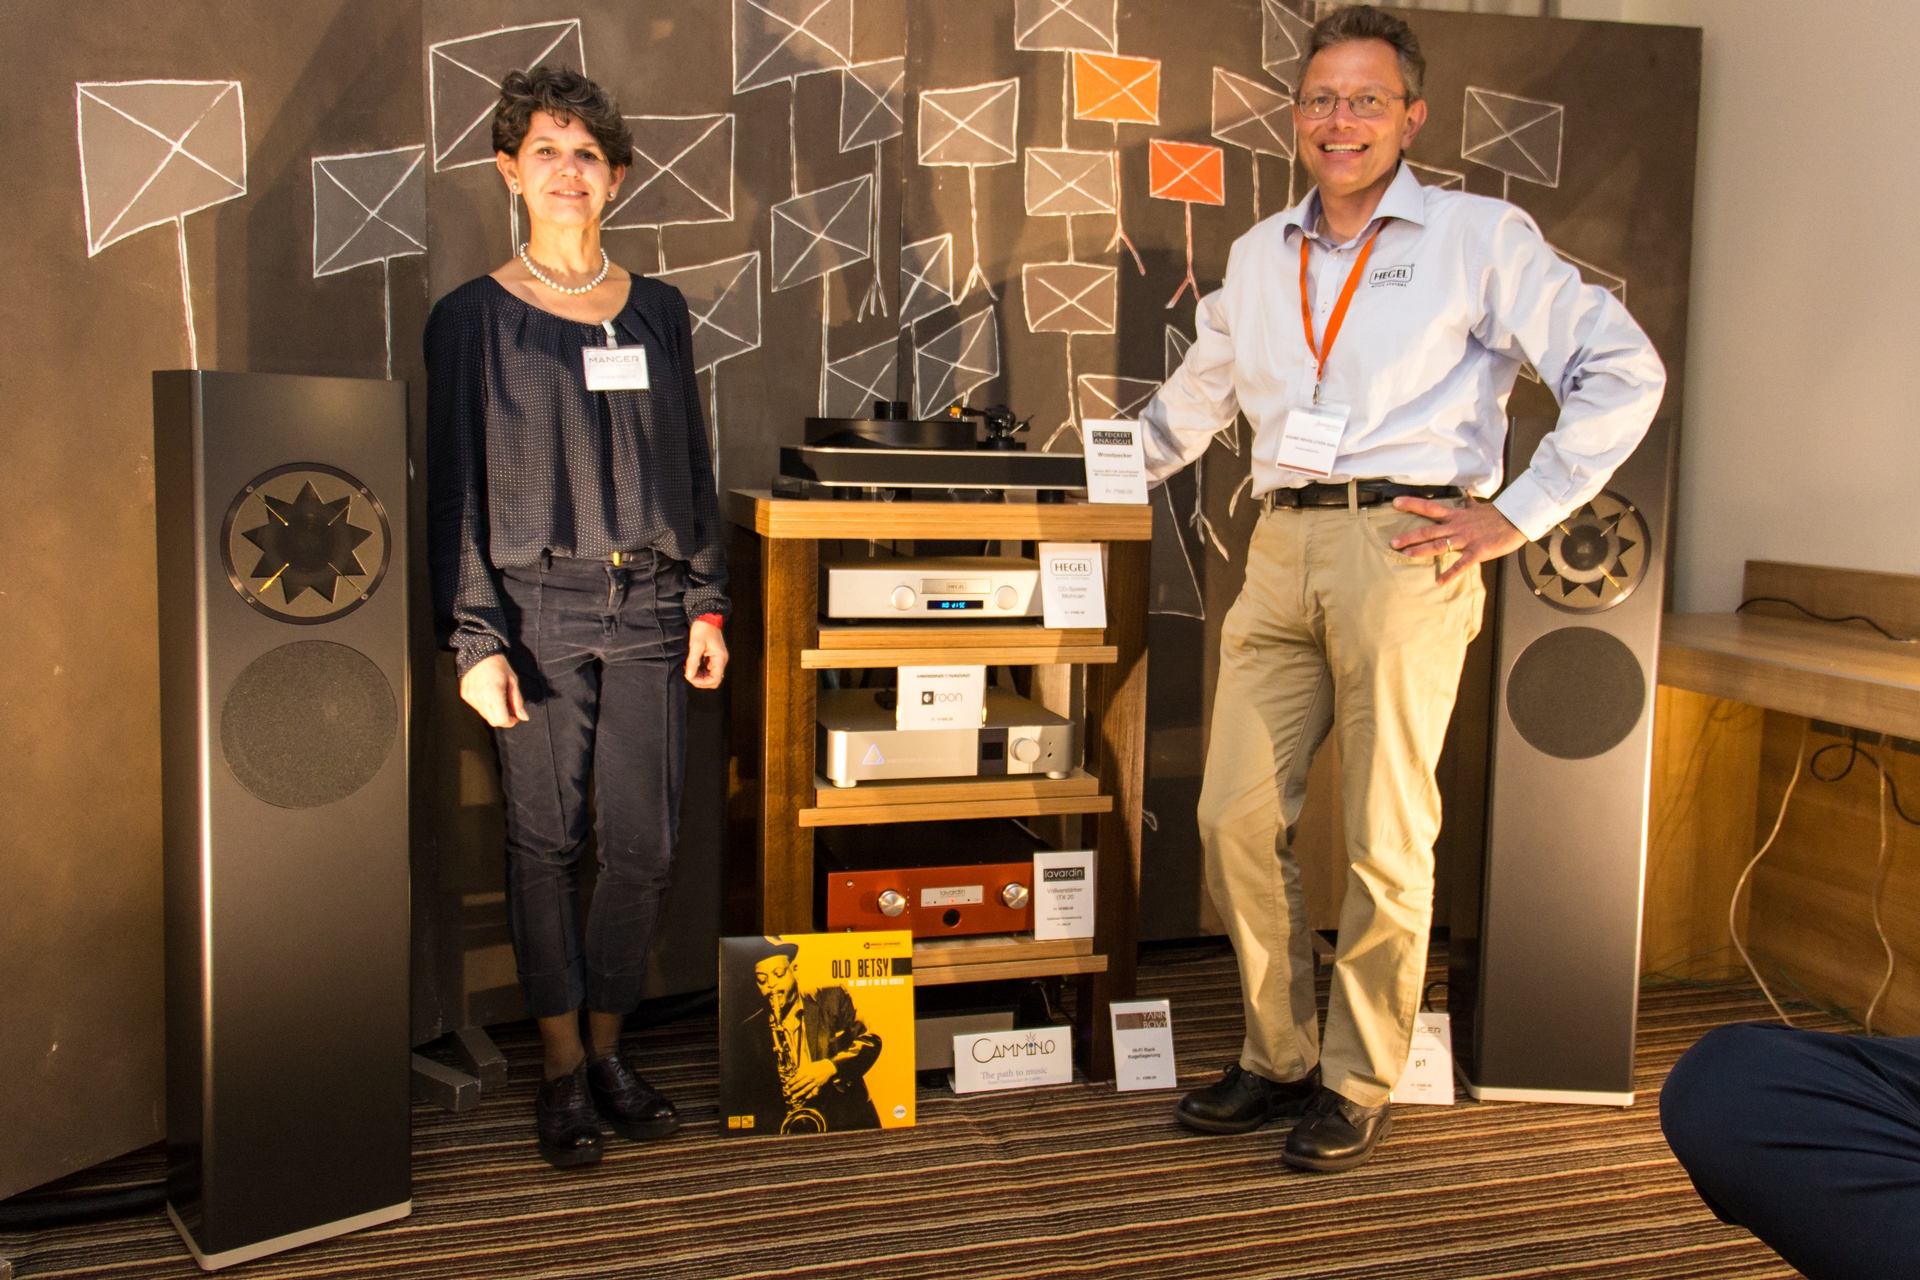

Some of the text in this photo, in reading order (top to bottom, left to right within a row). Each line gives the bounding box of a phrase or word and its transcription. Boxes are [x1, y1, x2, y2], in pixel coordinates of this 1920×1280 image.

[1373, 269, 1408, 281] HEGEL
[588, 355, 639, 364] MANGER
[1054, 563, 1089, 572] HEGEL
[934, 692, 963, 703] roon
[1044, 868, 1083, 878] lavardin
[939, 889, 966, 897] lavardin
[831, 957, 889, 979] OLD BETSY
[1142, 1011, 1166, 1020] YANN
[1142, 1020, 1167, 1029] BOVY
[1414, 1026, 1441, 1034] NGER
[1415, 1059, 1426, 1069] p1
[981, 1066, 1048, 1080] The path to music
